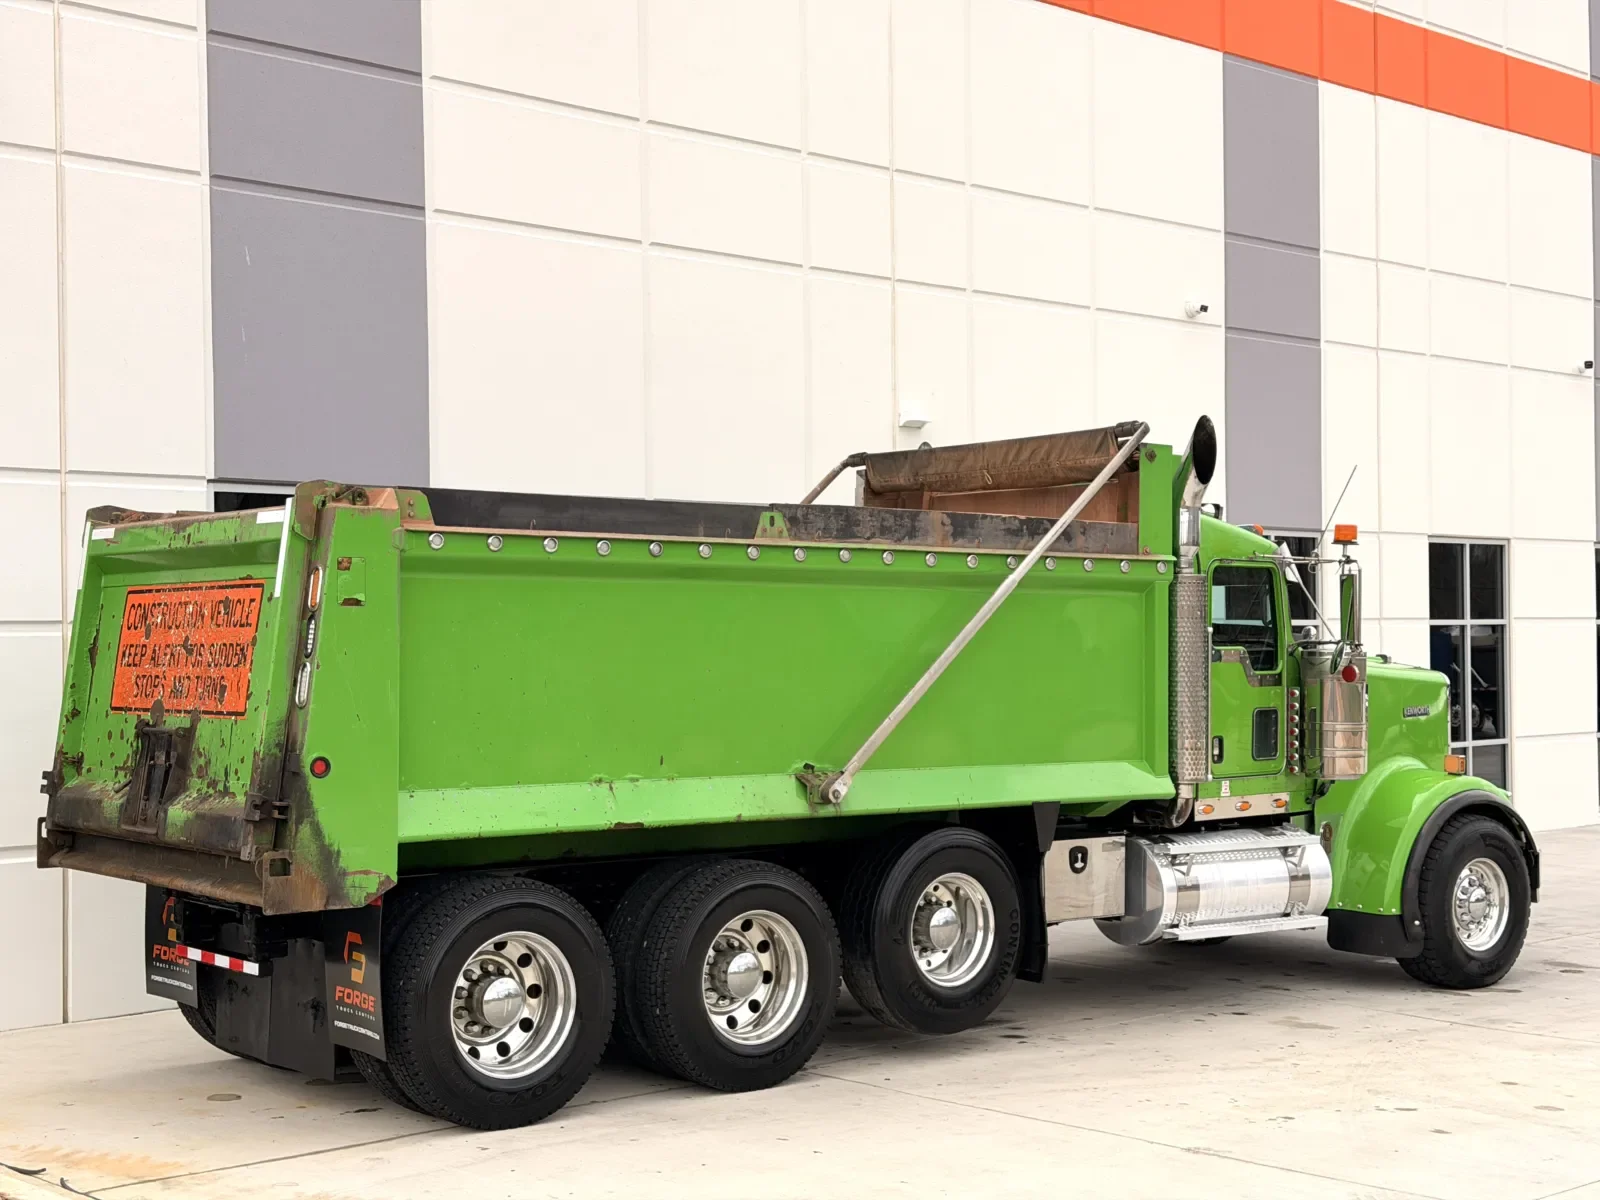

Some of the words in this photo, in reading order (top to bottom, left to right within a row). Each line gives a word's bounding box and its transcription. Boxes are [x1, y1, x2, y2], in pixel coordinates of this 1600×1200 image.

[127, 600, 206, 631] CONSTRUCTION
[210, 598, 256, 628] VEHICLE
[120, 643, 148, 667] KEEP
[150, 643, 183, 667] ALERT
[185, 642, 206, 668] FOR
[207, 642, 249, 667] SUDDEN
[134, 671, 167, 698] STOPS
[168, 674, 191, 699] AND
[335, 985, 376, 1012] FORGE
